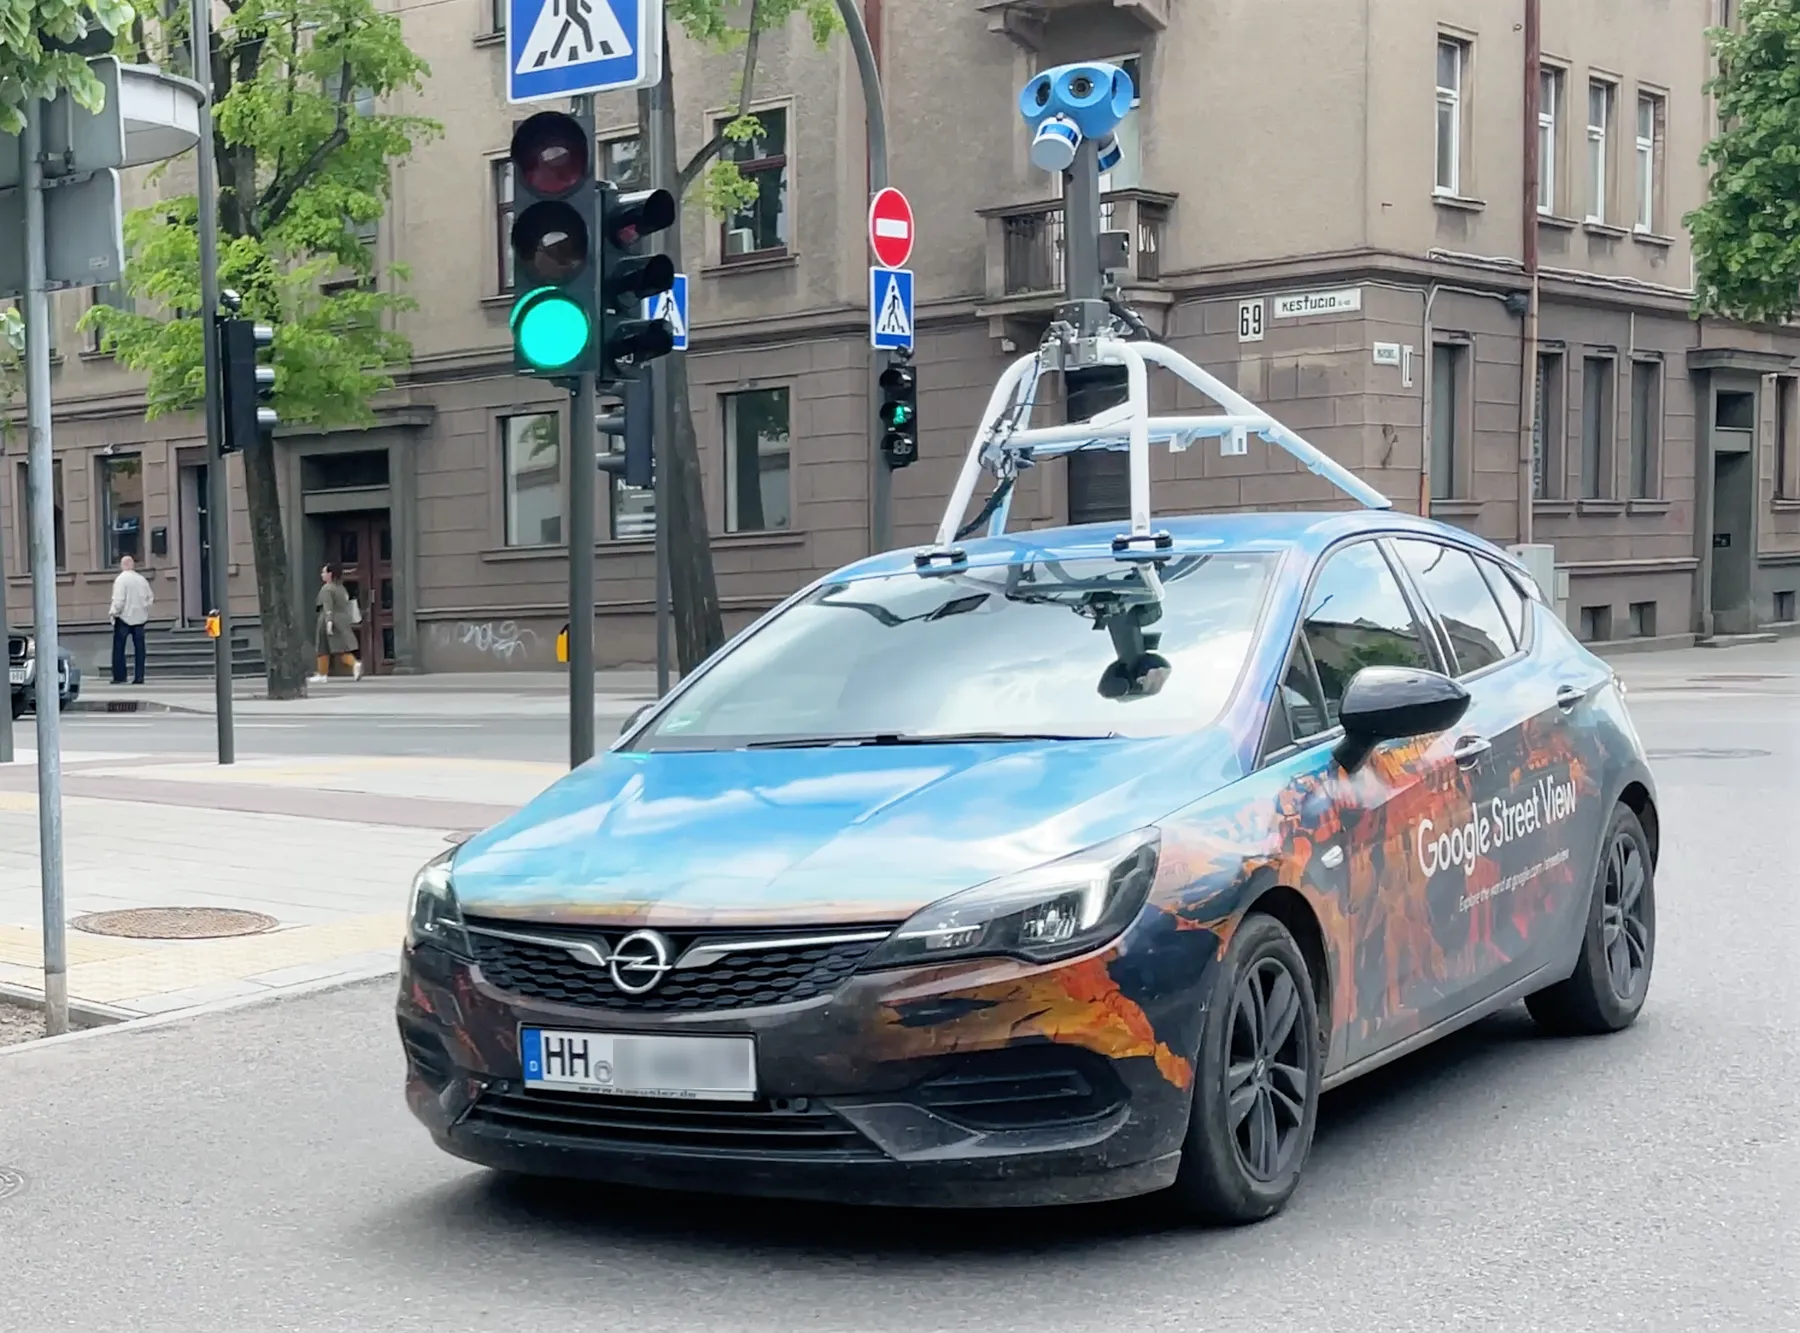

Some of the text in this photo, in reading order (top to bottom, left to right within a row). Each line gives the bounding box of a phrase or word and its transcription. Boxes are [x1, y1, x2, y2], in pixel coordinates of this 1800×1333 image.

[1241, 304, 1261, 336] 69
[1418, 775, 1577, 877] Google Street View
[529, 1060, 538, 1072] D
[545, 1036, 590, 1078] HH
